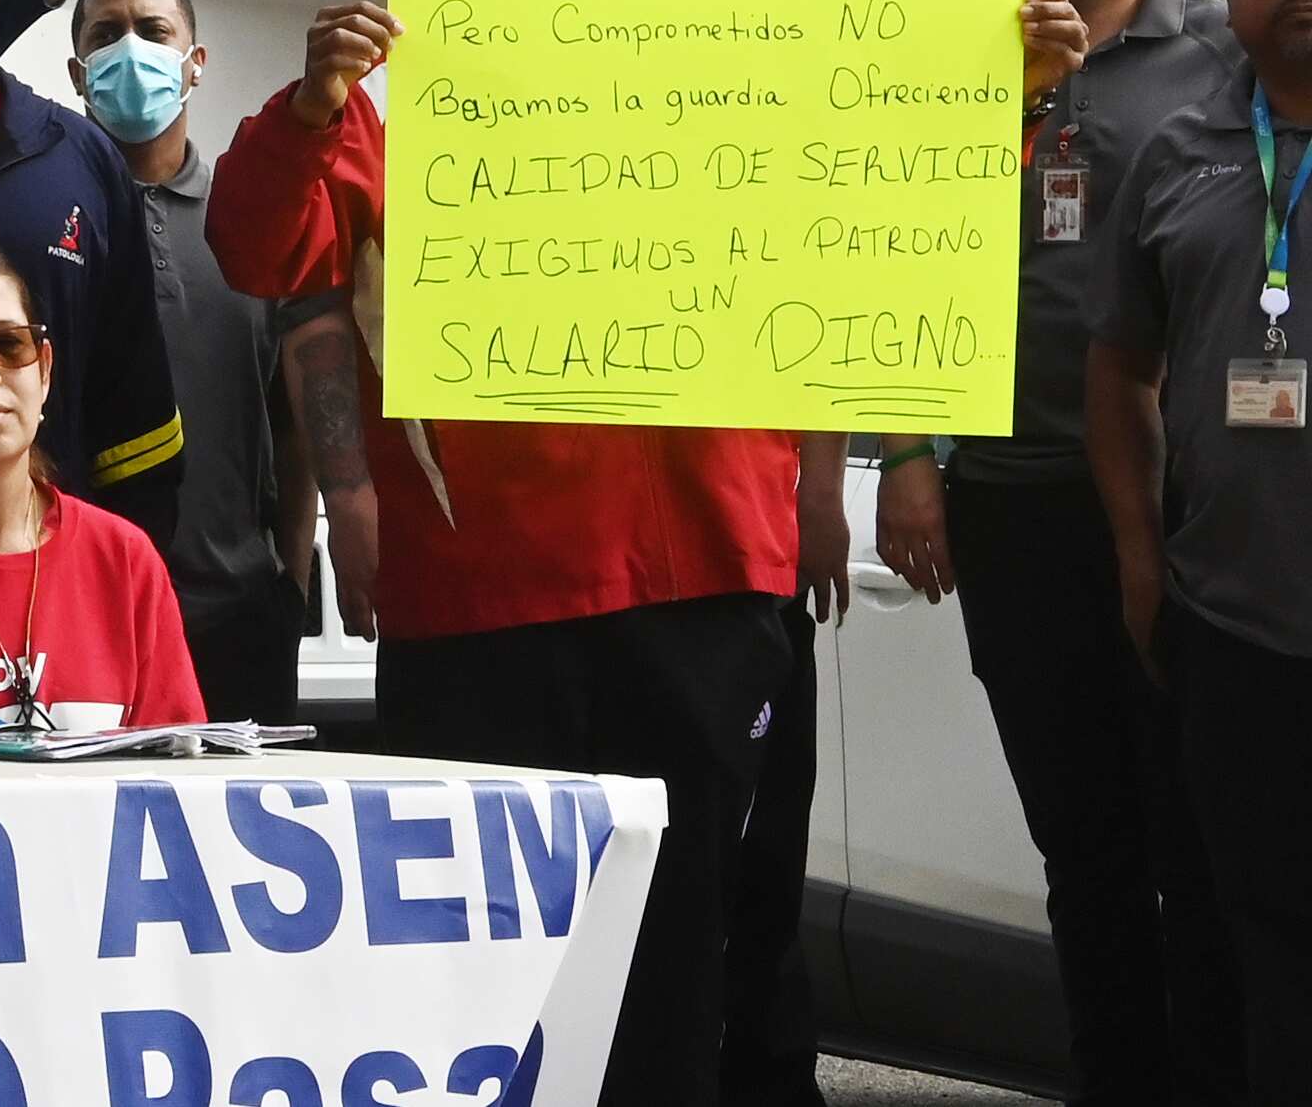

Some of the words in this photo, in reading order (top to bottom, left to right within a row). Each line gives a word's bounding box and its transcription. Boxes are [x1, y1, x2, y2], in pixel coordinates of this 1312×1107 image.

[551, 2, 804, 56] Comprometidos
[837, 0, 906, 43] NO
[414, 77, 590, 128] Bajamos
[613, 78, 643, 111] la
[666, 79, 787, 126] guardia
[828, 64, 1010, 111] Ofreciendo
[424, 151, 680, 208] CALIDAD
[704, 147, 775, 192] DE
[797, 141, 1018, 187] SERVICIO
[413, 235, 696, 287] EXIGIMOS
[729, 228, 780, 266] AL
[803, 215, 984, 260] PATRONO
[433, 321, 705, 383] SALARIO
[97, 779, 616, 960] ASEM
